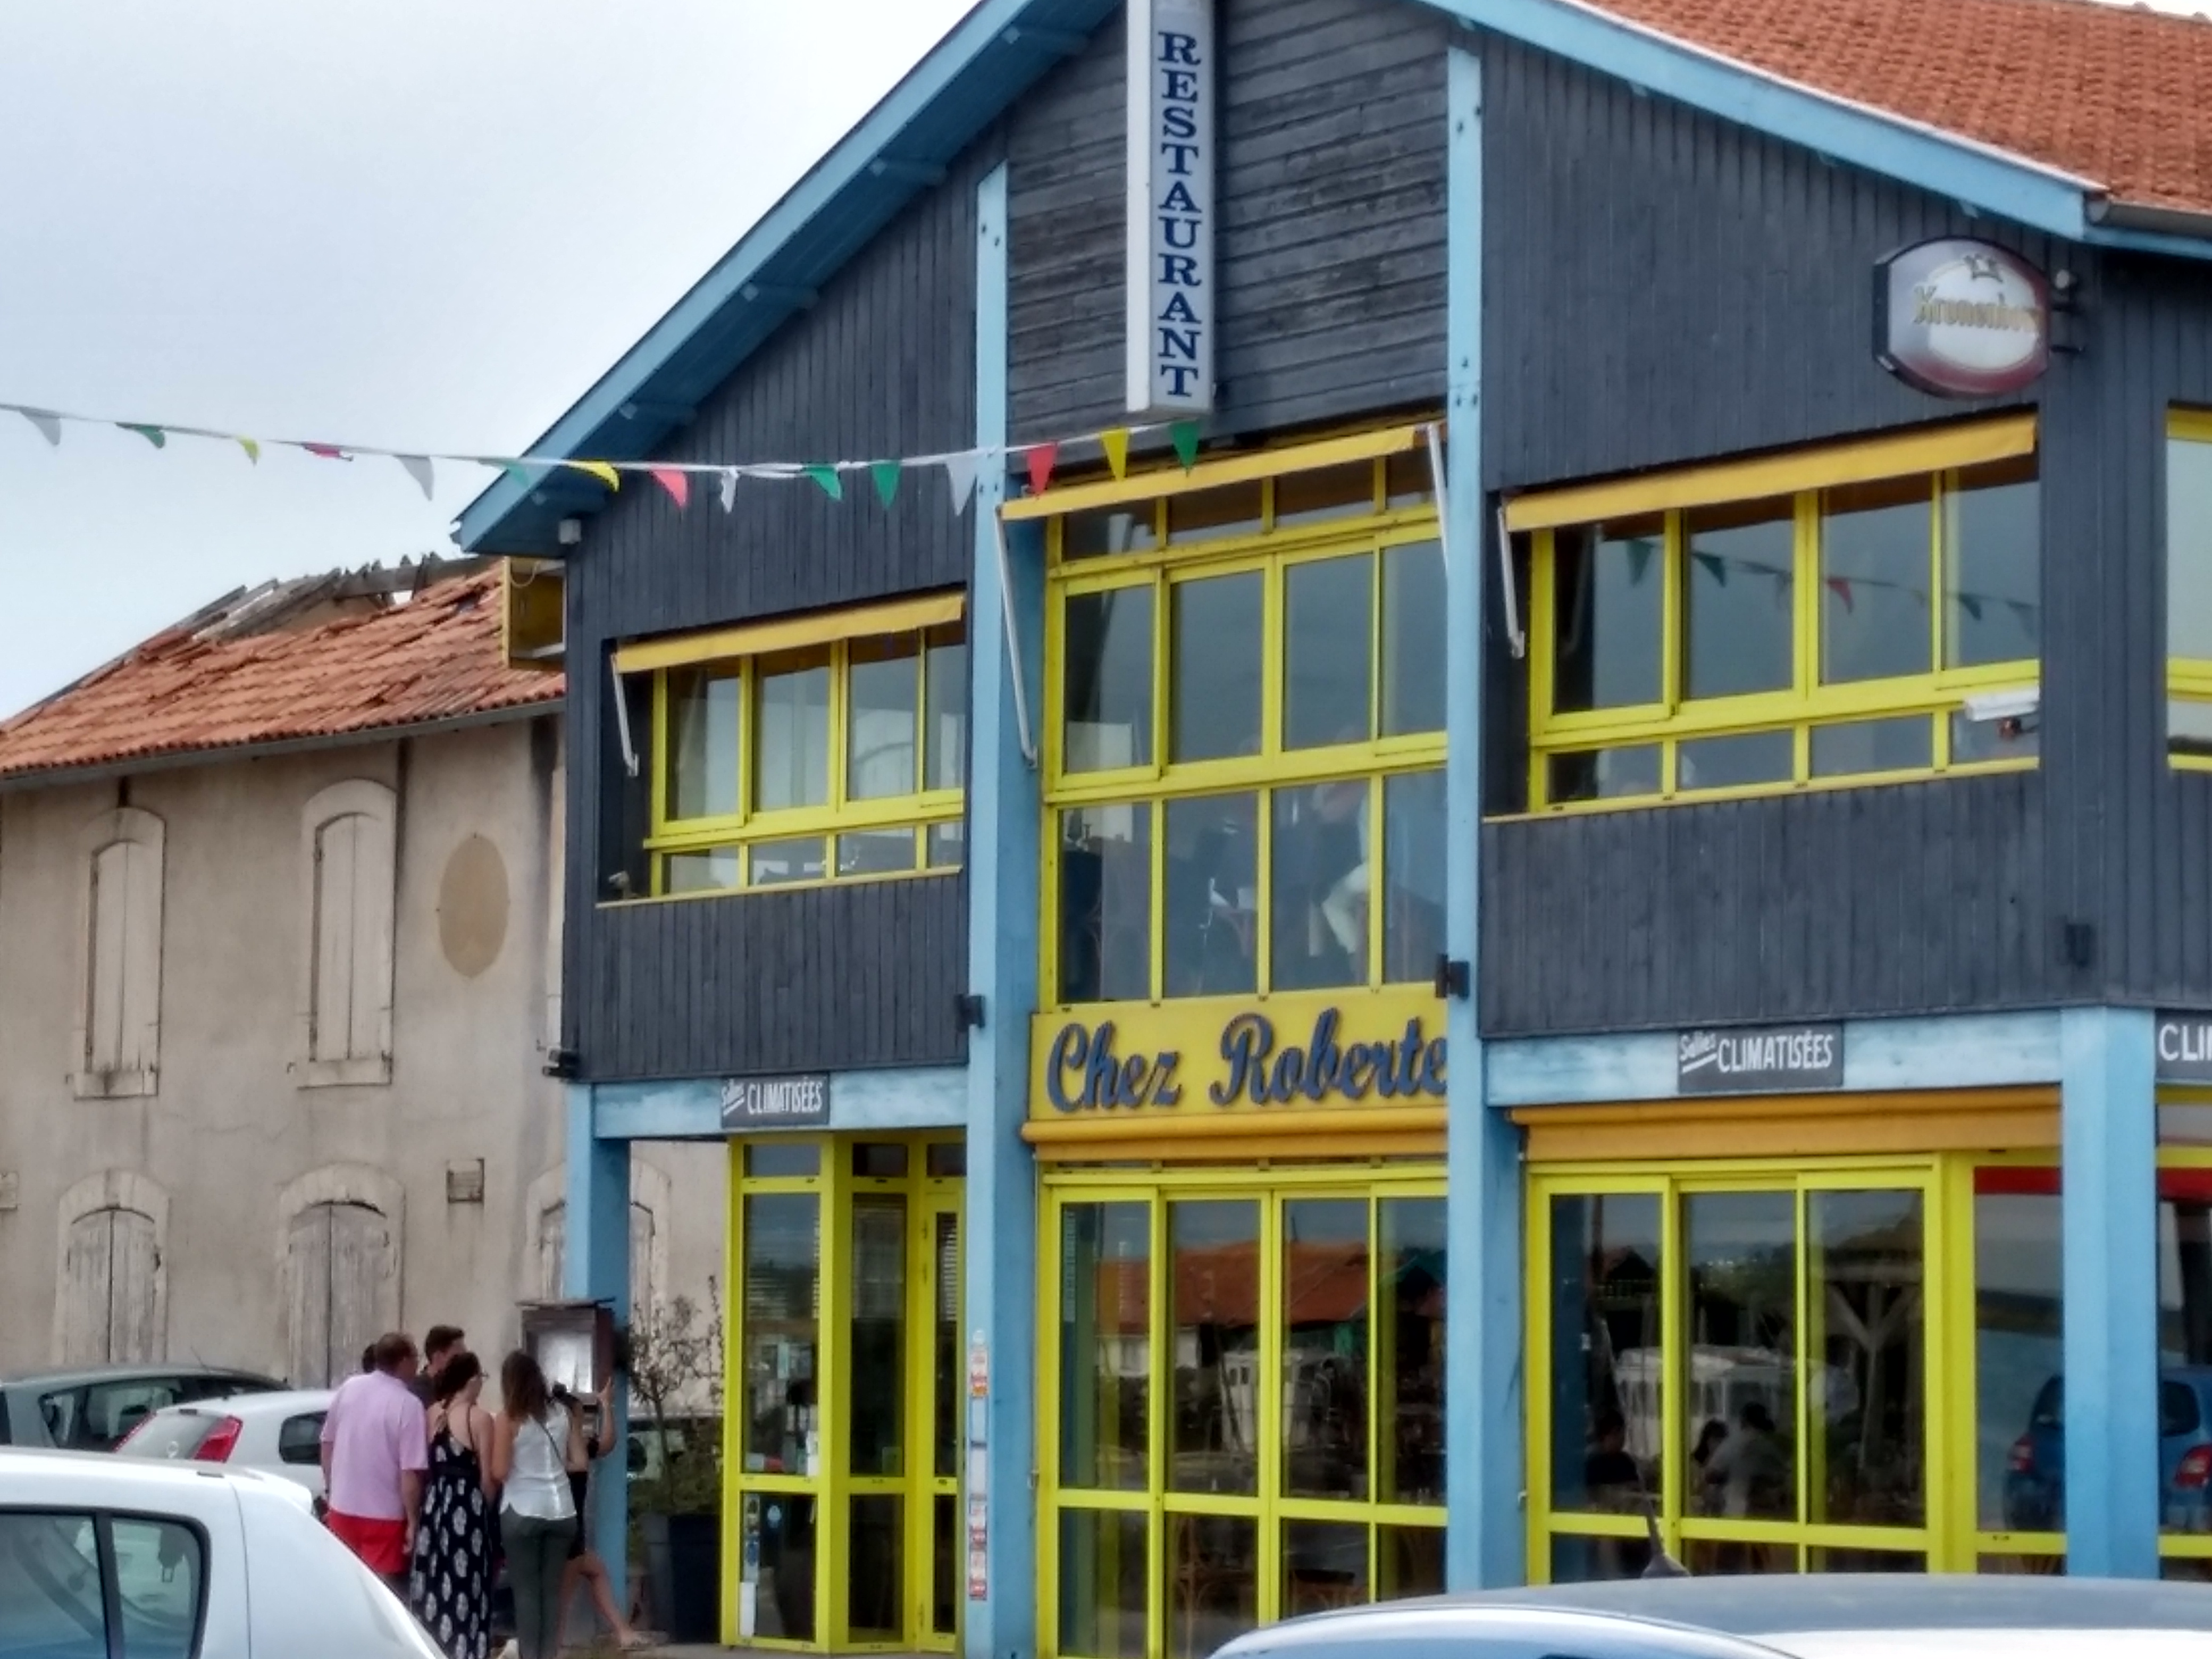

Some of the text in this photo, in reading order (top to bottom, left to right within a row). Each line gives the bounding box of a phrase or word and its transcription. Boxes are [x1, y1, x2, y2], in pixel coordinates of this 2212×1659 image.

[1158, 31, 1202, 397] RESTAURANT
[1048, 1008, 1447, 1113] Chez Roberte
[1717, 1030, 1834, 1073] CLIMATISÉES
[2159, 1024, 2212, 1061] CLI
